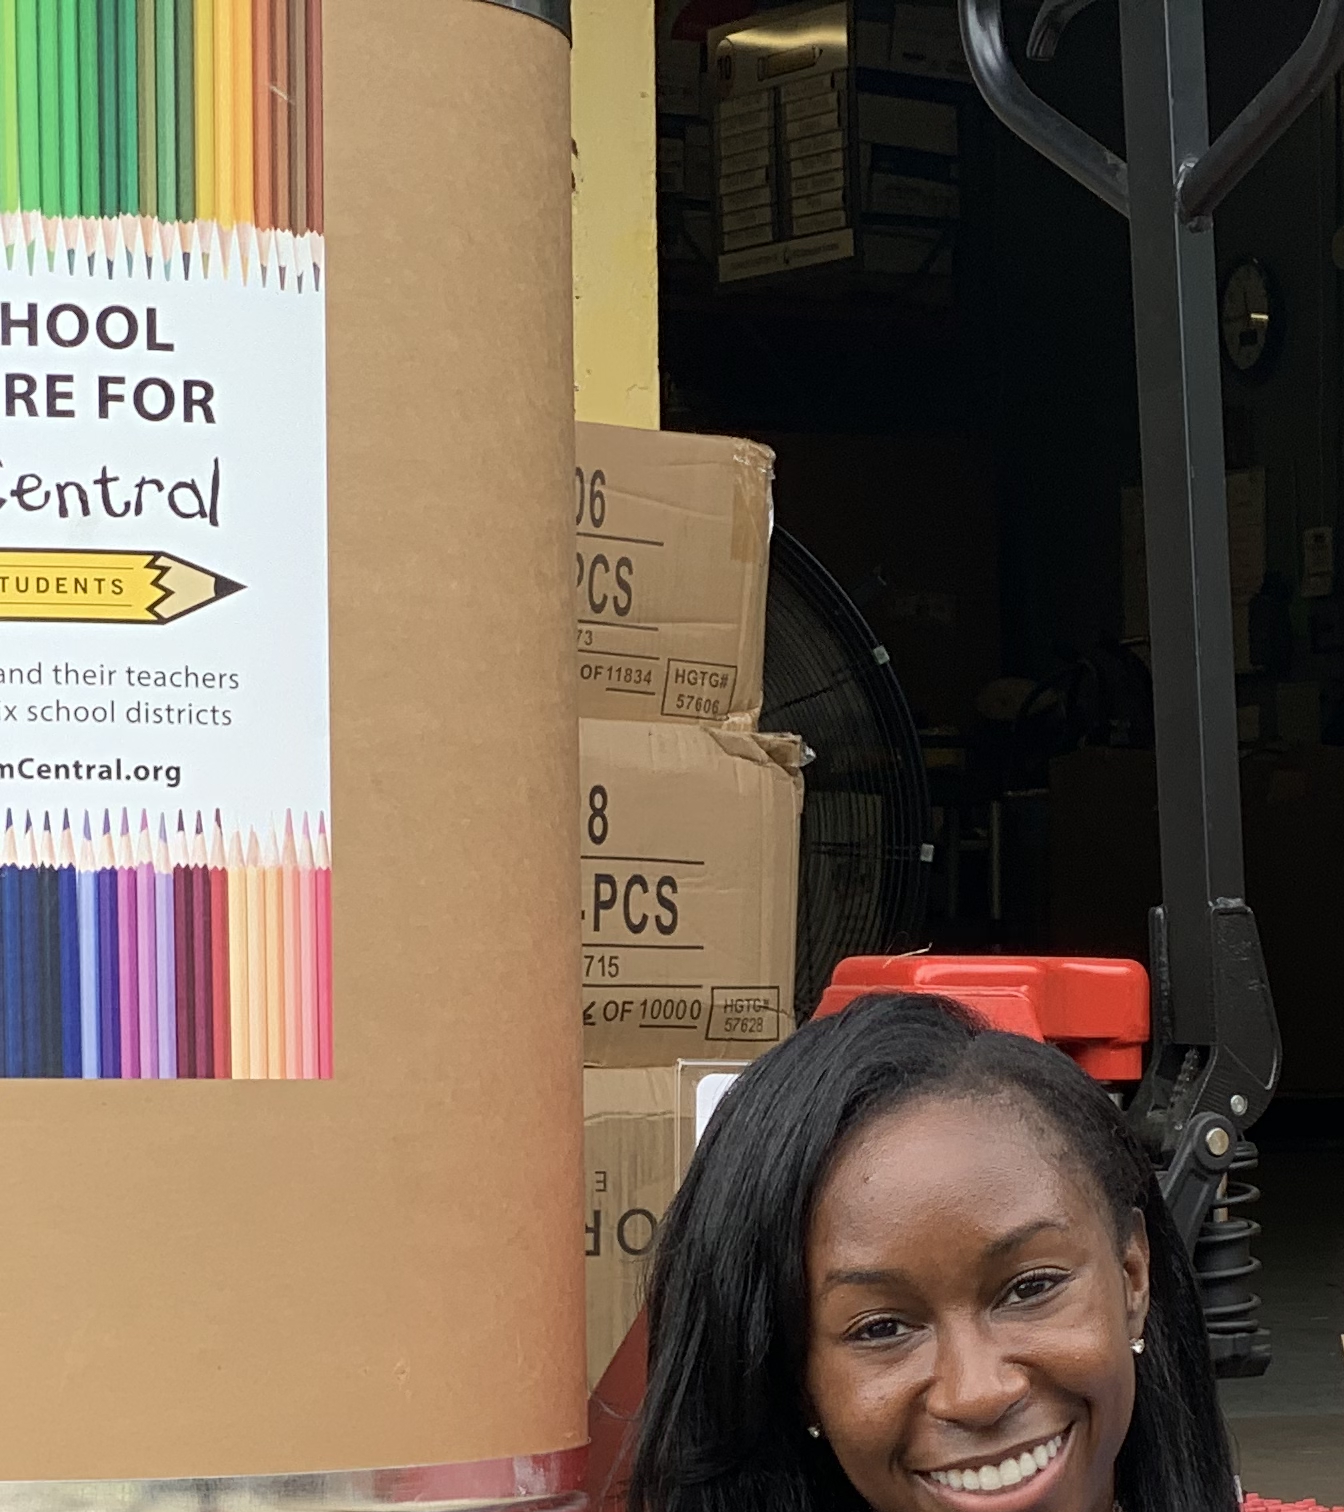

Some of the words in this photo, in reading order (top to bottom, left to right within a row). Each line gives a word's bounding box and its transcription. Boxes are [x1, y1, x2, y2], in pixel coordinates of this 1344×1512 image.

[98, 376, 216, 424] FOR
[0, 456, 220, 527] entral
[52, 663, 117, 687] their
[126, 665, 240, 690] teachers
[580, 664, 603, 680] OF
[607, 666, 652, 684] 11834
[674, 668, 729, 689] HGTG#
[27, 700, 115, 723] school
[125, 700, 233, 726] districts
[676, 694, 720, 714] 57606
[593, 873, 678, 935] PCS
[603, 1000, 634, 1022] OF
[640, 998, 701, 1021] 10000
[724, 1018, 763, 1033] 57628
